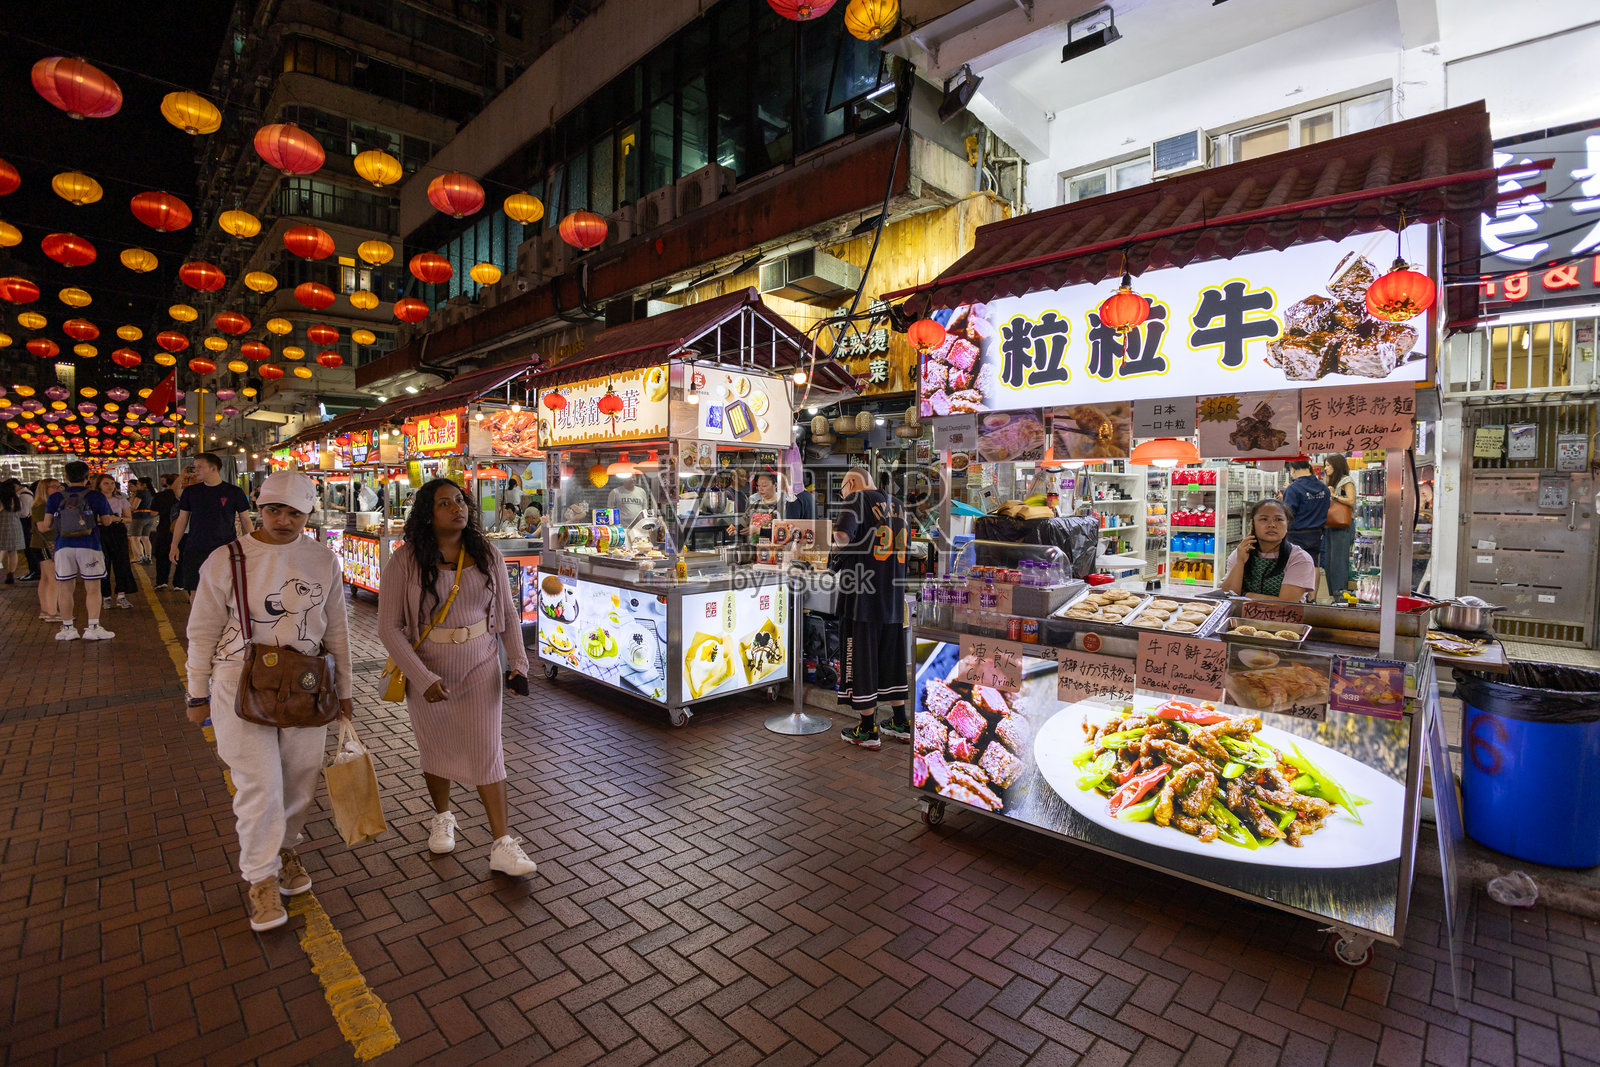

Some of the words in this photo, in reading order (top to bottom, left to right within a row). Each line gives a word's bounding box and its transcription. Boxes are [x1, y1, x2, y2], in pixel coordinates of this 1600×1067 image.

[1001, 281, 1281, 388] 粒粒牛
[557, 389, 641, 430] 現烤舒蕾
[1153, 404, 1177, 415] 日本
[1142, 418, 1187, 430] 一口牛粒
[873, 525, 909, 564] 34
[1147, 638, 1202, 665] 牛肉餅
[991, 673, 1017, 688] Drink
